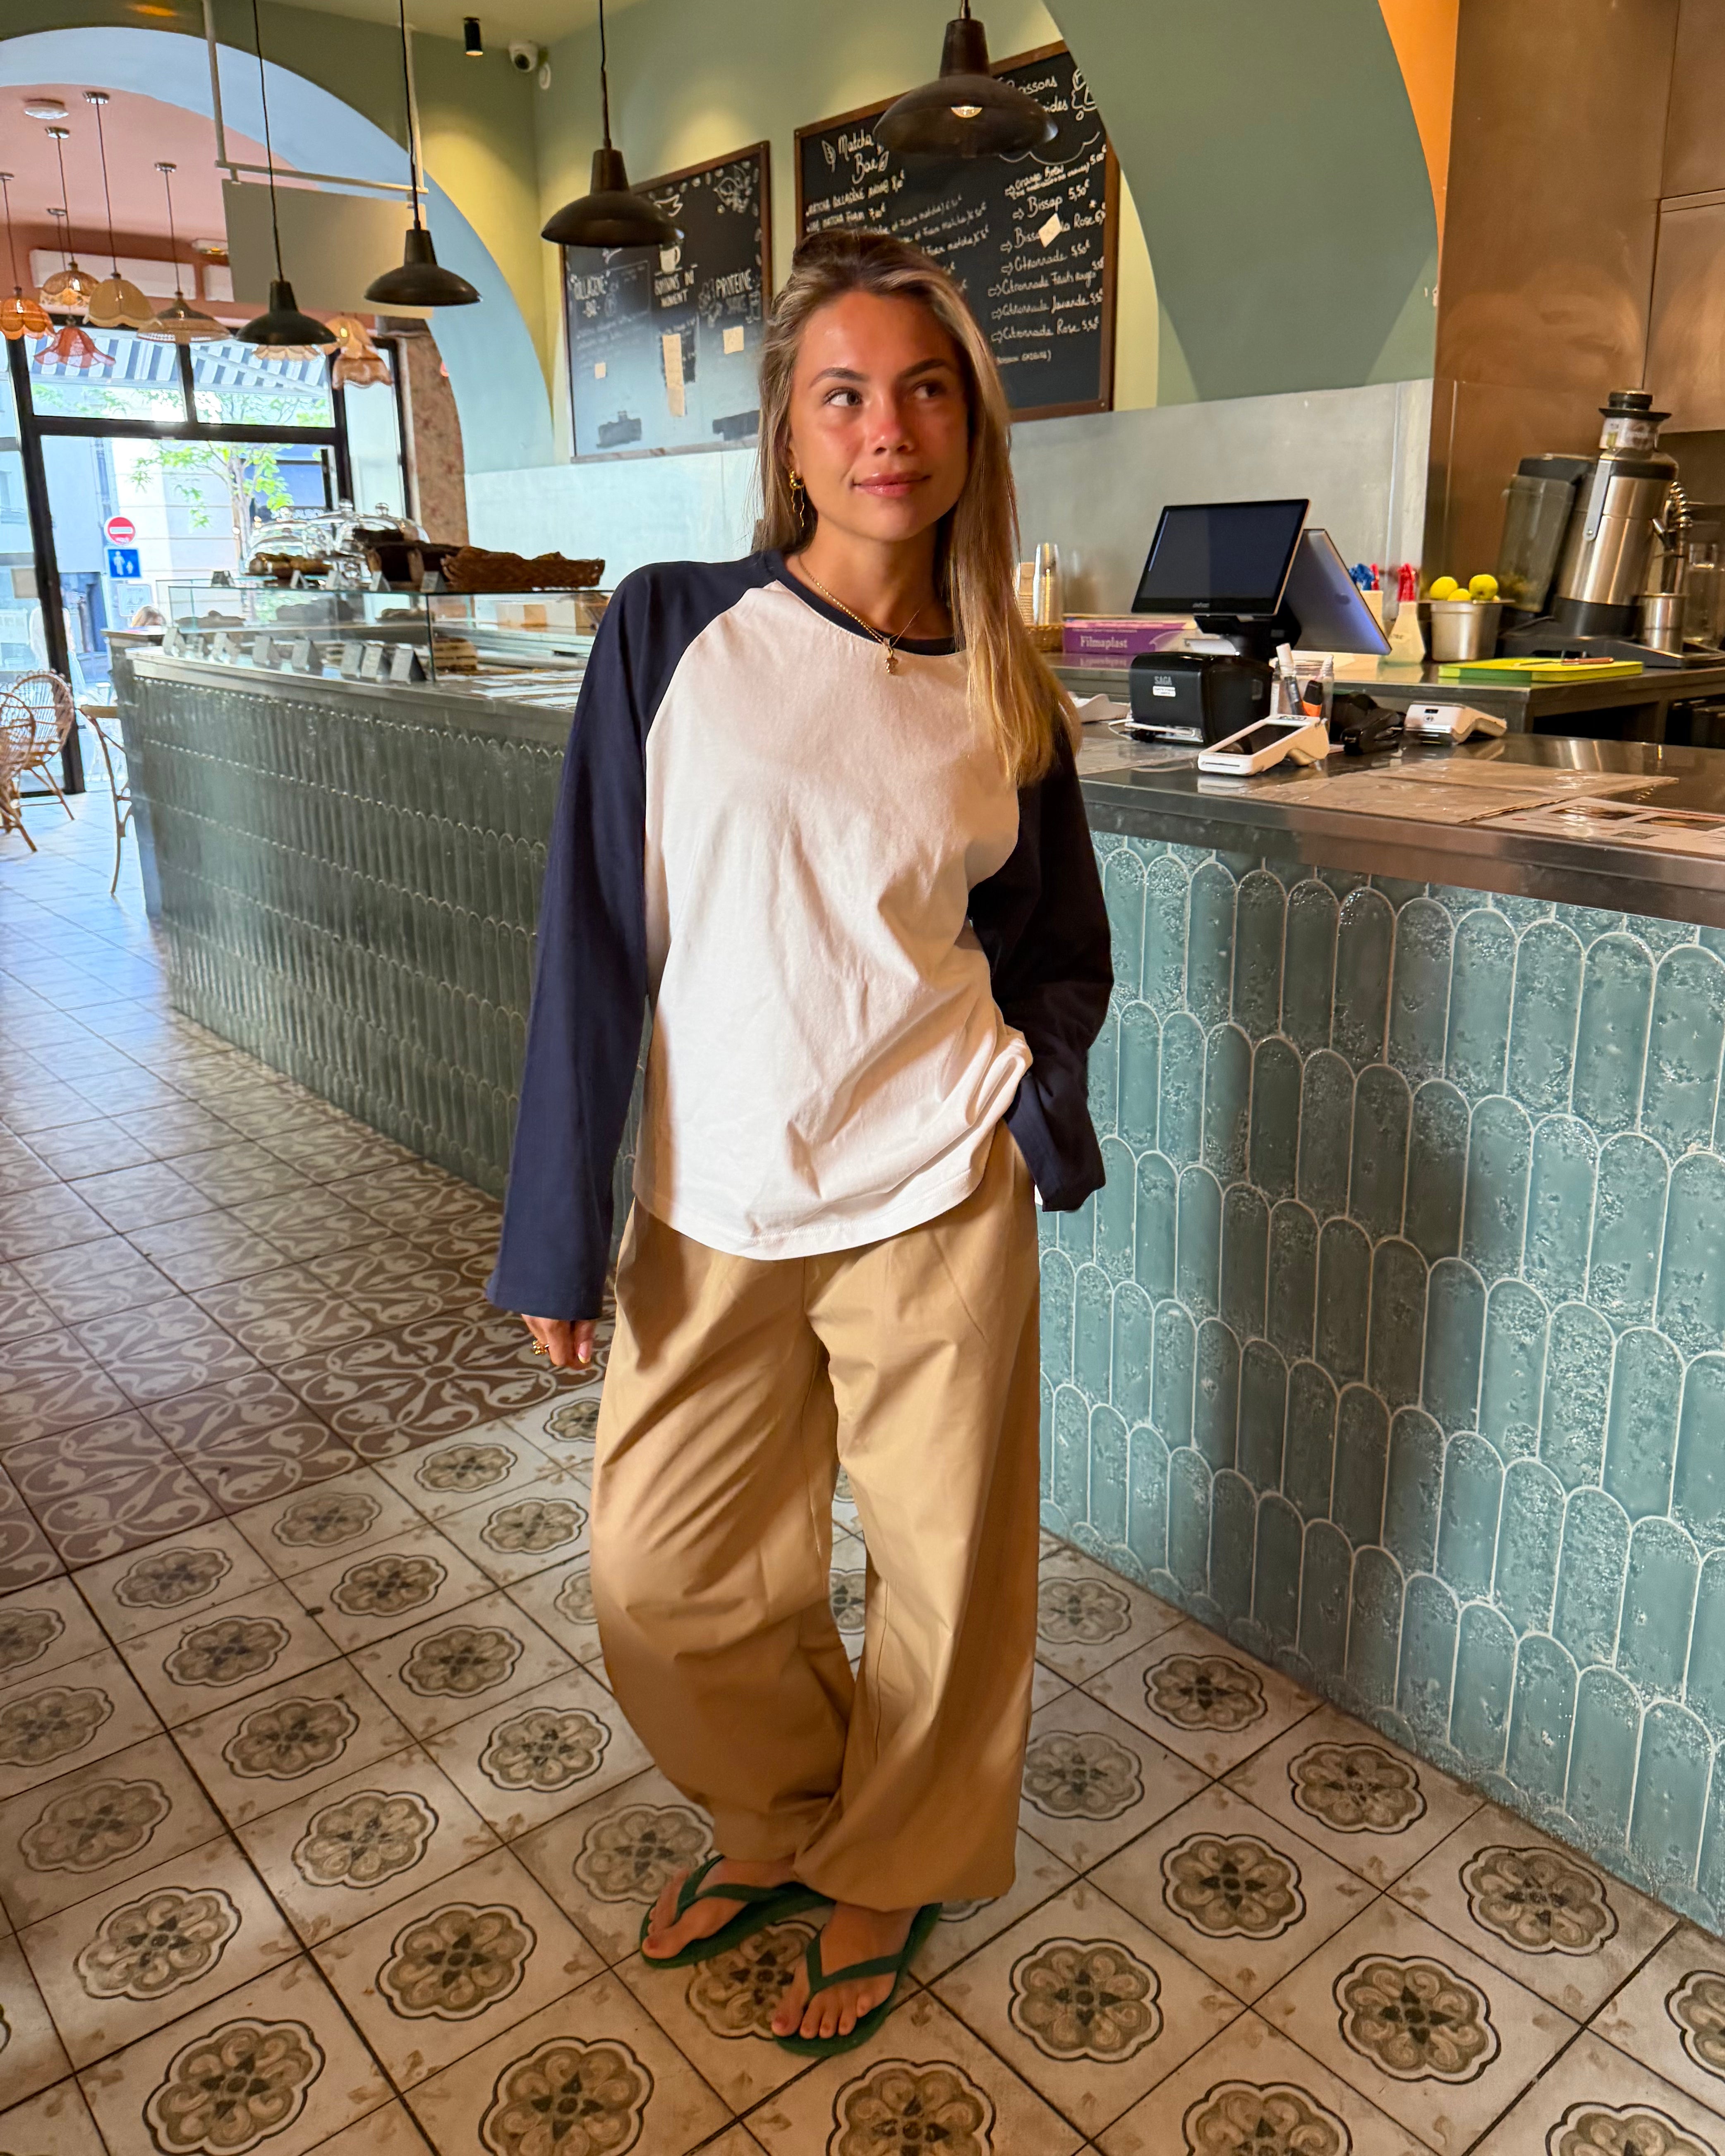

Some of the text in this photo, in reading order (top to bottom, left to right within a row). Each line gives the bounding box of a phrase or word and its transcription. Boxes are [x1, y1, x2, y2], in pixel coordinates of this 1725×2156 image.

[838, 129, 874, 161] Matcha
[851, 152, 878, 184] Bar
[1027, 196, 1063, 218] Bissap
[1074, 213, 1095, 228] Rose
[1014, 249, 1068, 271] Citronnade
[1057, 317, 1081, 335] Rose
[1081, 635, 1128, 650] Filmaplast
